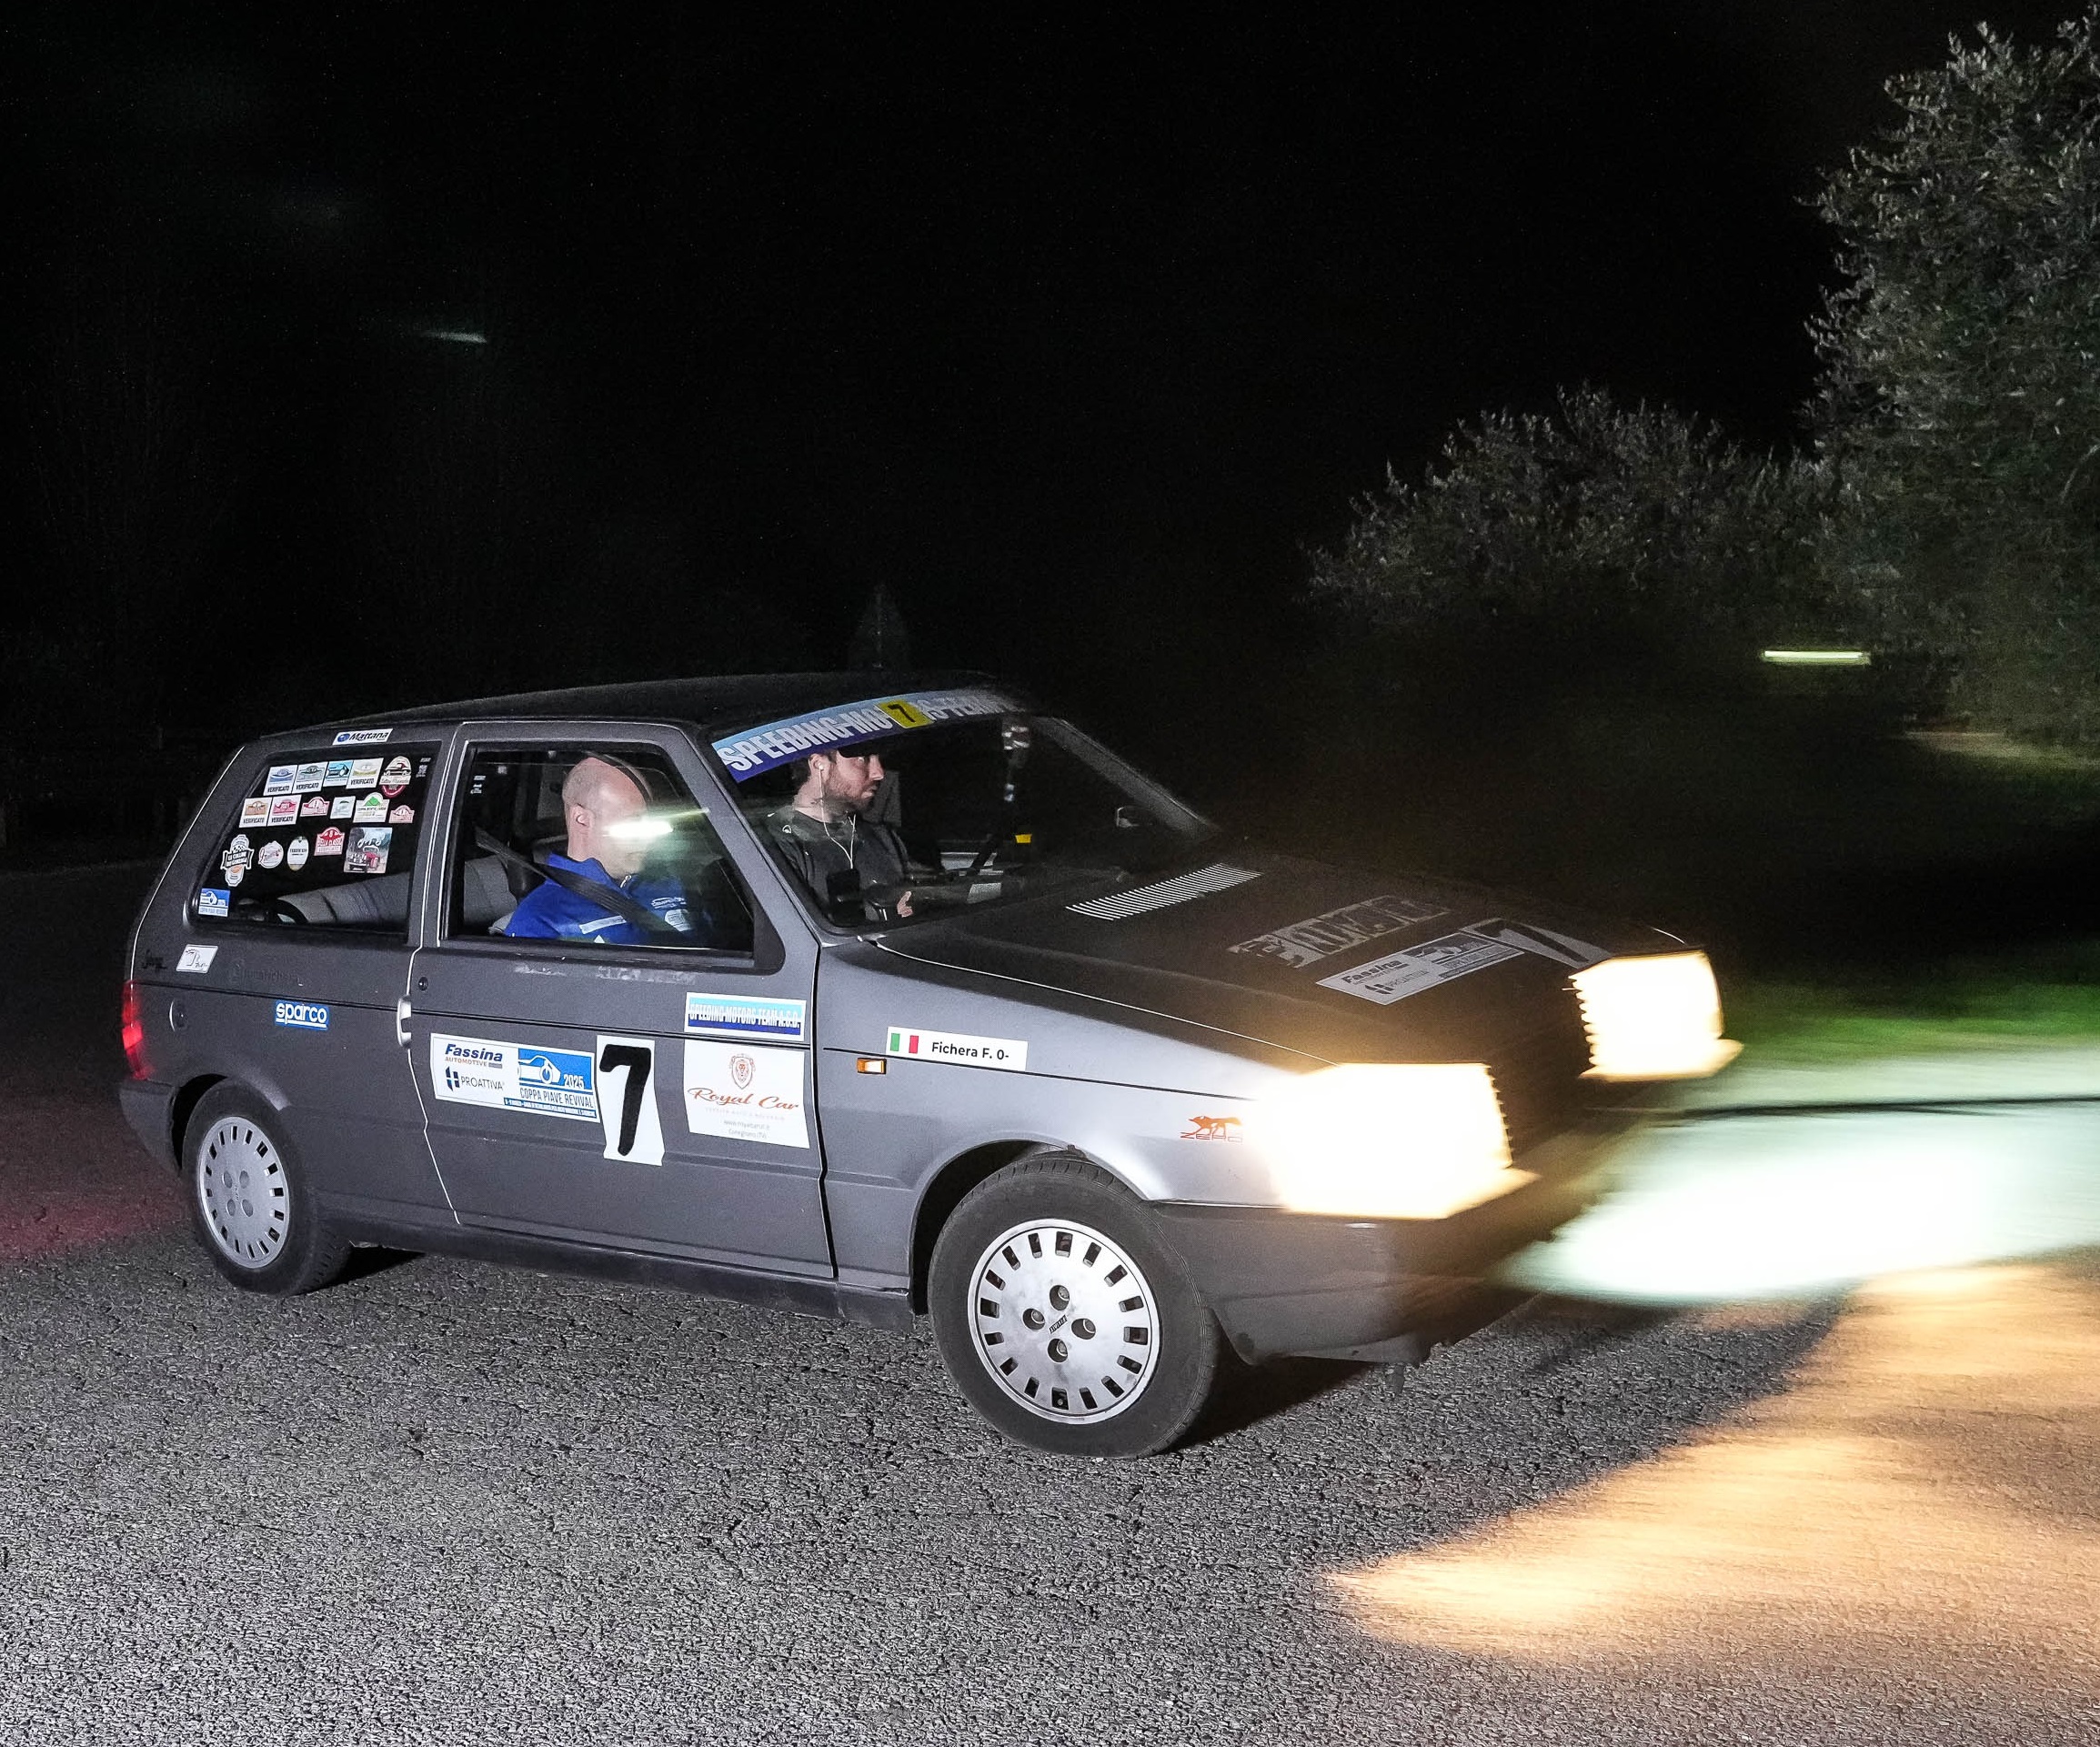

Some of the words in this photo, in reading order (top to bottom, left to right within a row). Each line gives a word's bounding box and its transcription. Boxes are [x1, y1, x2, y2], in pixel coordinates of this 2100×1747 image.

[888, 703, 916, 723] 7
[349, 731, 388, 741] Mattana
[717, 717, 849, 771] SPEEDING
[276, 1003, 327, 1024] sparco
[445, 1043, 503, 1062] Fassina
[931, 1041, 978, 1058] Fichera
[982, 1048, 992, 1059] F.
[445, 1057, 487, 1067] AUTOMOTIVE
[461, 1076, 503, 1090] PROATTIVA
[564, 1074, 585, 1089] 2025
[519, 1088, 542, 1101] COPPA
[543, 1090, 562, 1105] PIAVE
[564, 1093, 594, 1109] REVIVAL
[598, 1043, 651, 1156] 7
[688, 1087, 754, 1106] Royal
[759, 1096, 799, 1109] Car
